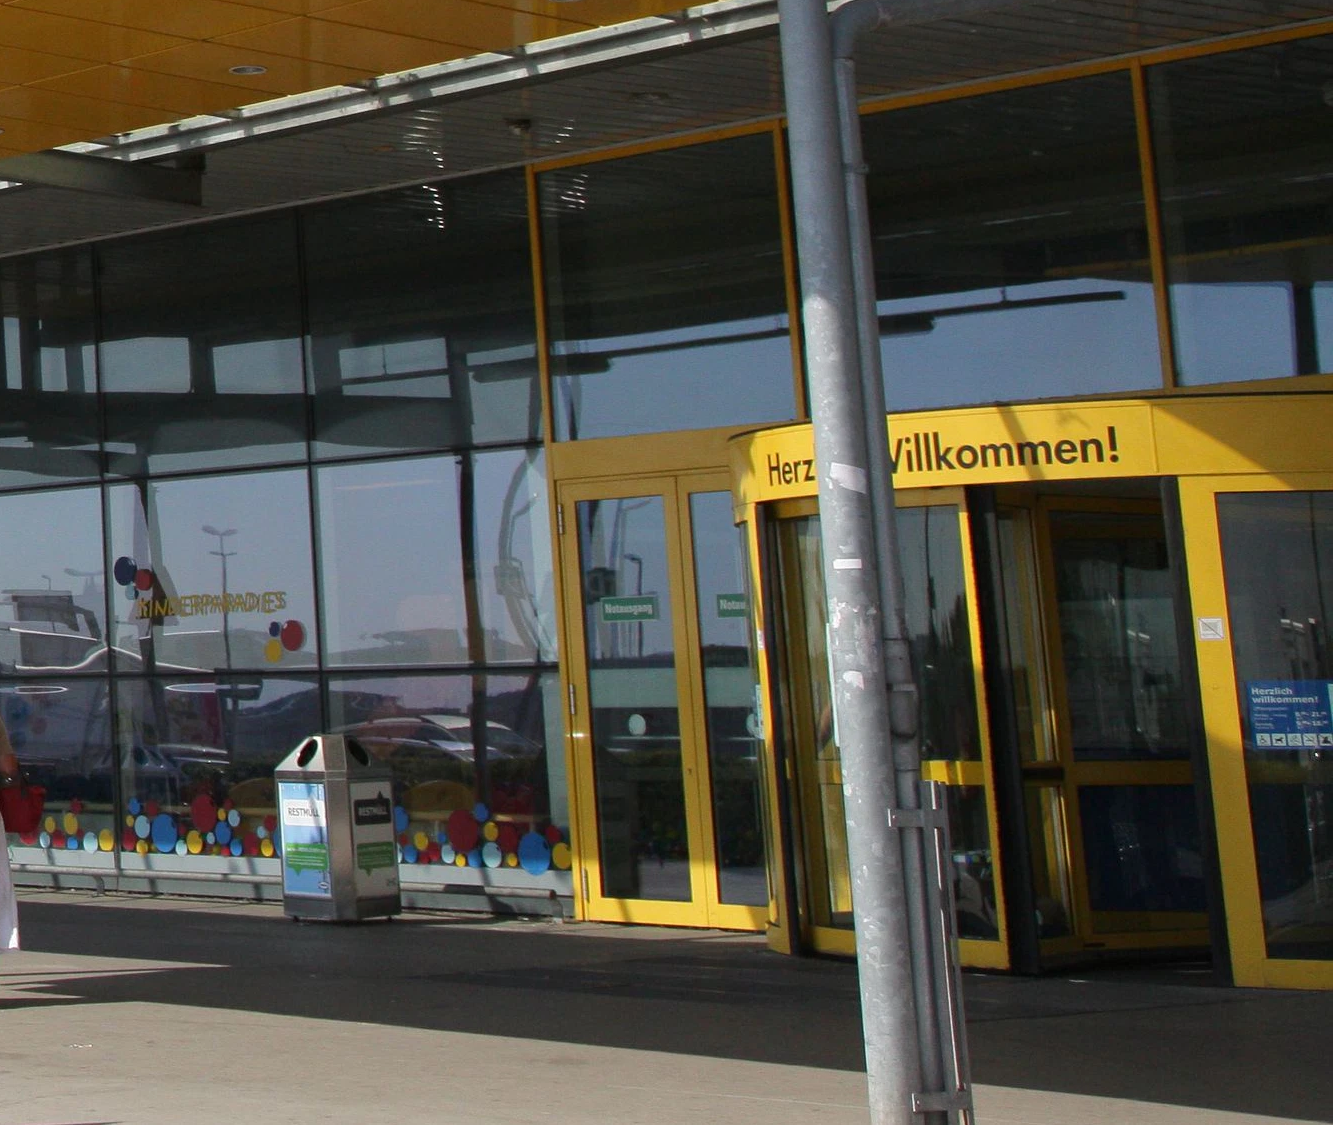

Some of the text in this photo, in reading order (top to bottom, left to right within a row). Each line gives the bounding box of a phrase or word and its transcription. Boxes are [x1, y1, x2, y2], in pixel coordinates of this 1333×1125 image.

[767, 452, 815, 486] Herz
[138, 591, 286, 619] KINDERPARADIES
[605, 603, 653, 615] Notausgang
[719, 599, 746, 610] Notau
[1251, 687, 1293, 695] Herzlich
[1251, 696, 1318, 704] willkommen!
